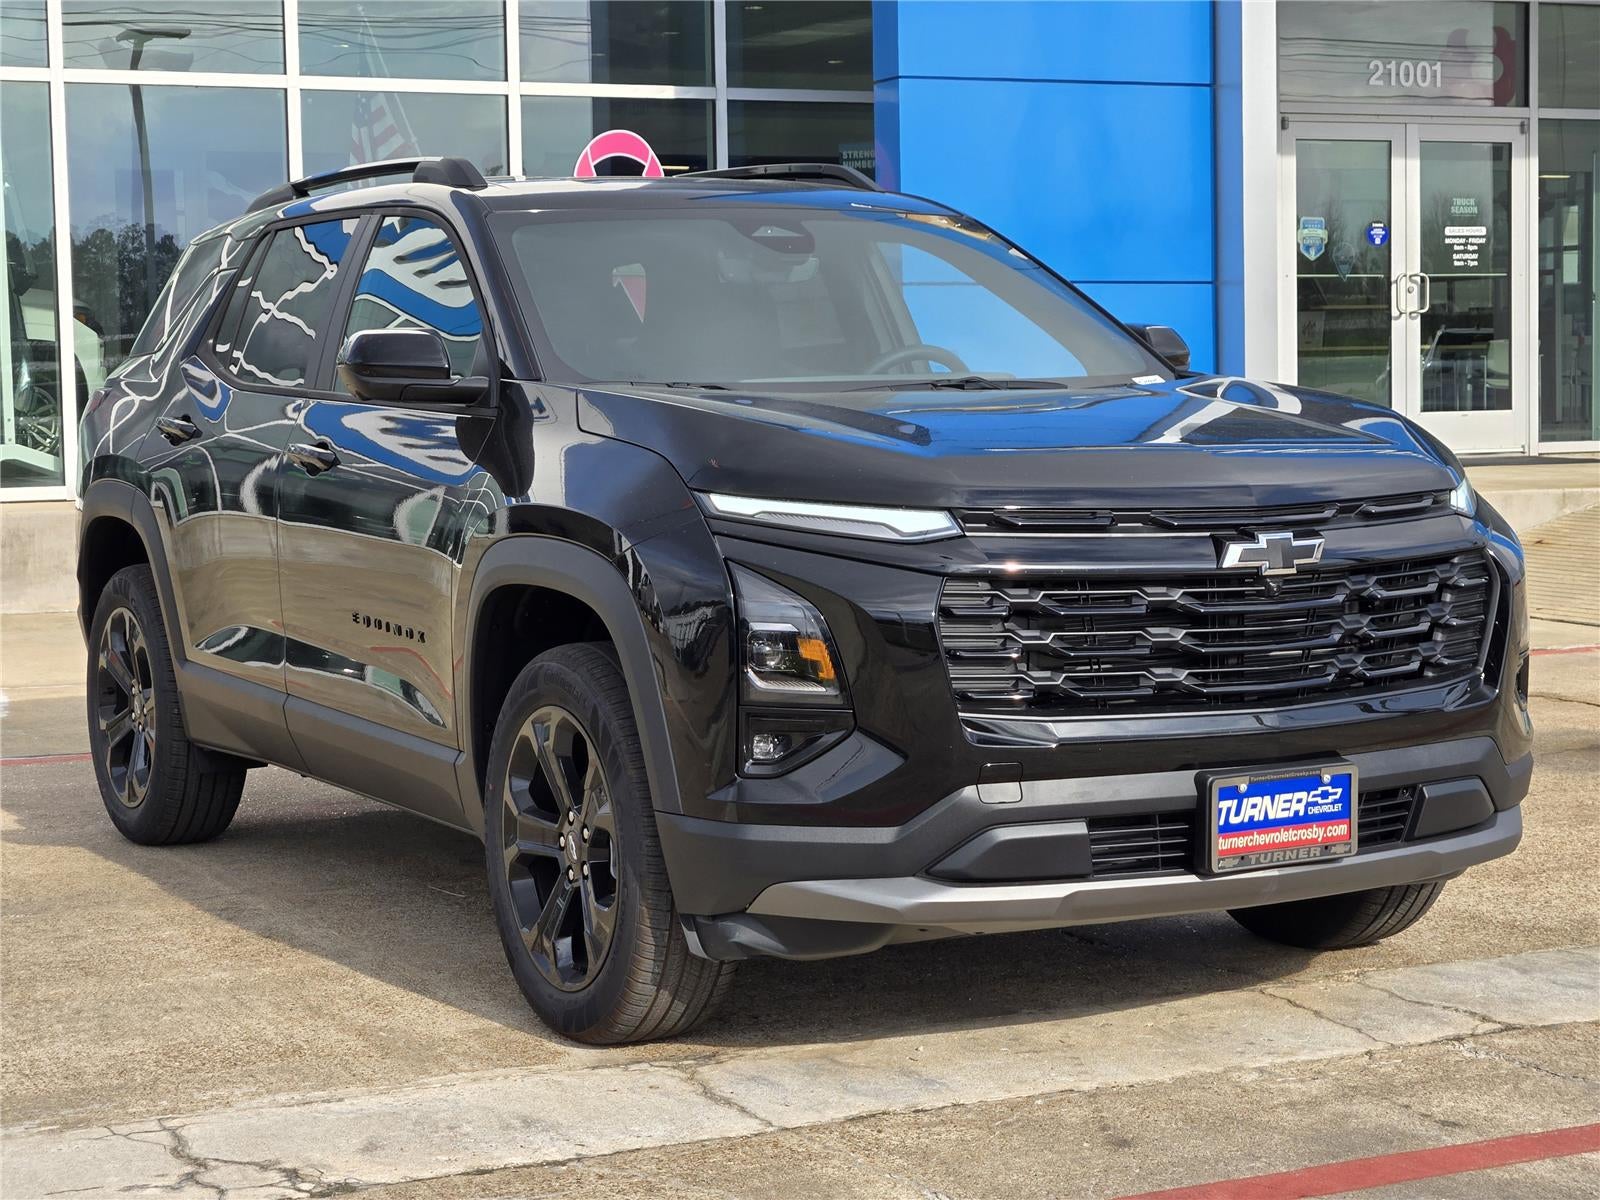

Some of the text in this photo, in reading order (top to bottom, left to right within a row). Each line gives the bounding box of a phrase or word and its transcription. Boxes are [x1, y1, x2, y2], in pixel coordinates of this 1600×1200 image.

[1369, 60, 1441, 88] 21001
[1450, 206, 1478, 214] SEASON
[1453, 198, 1475, 206] TRUCK
[352, 612, 426, 643] EQUINOX
[1218, 792, 1308, 826] TURNER
[1308, 803, 1342, 815] CHEVROLET
[1218, 823, 1348, 850] turnerchevroletcrosby.com
[1249, 847, 1321, 865] TURNER
